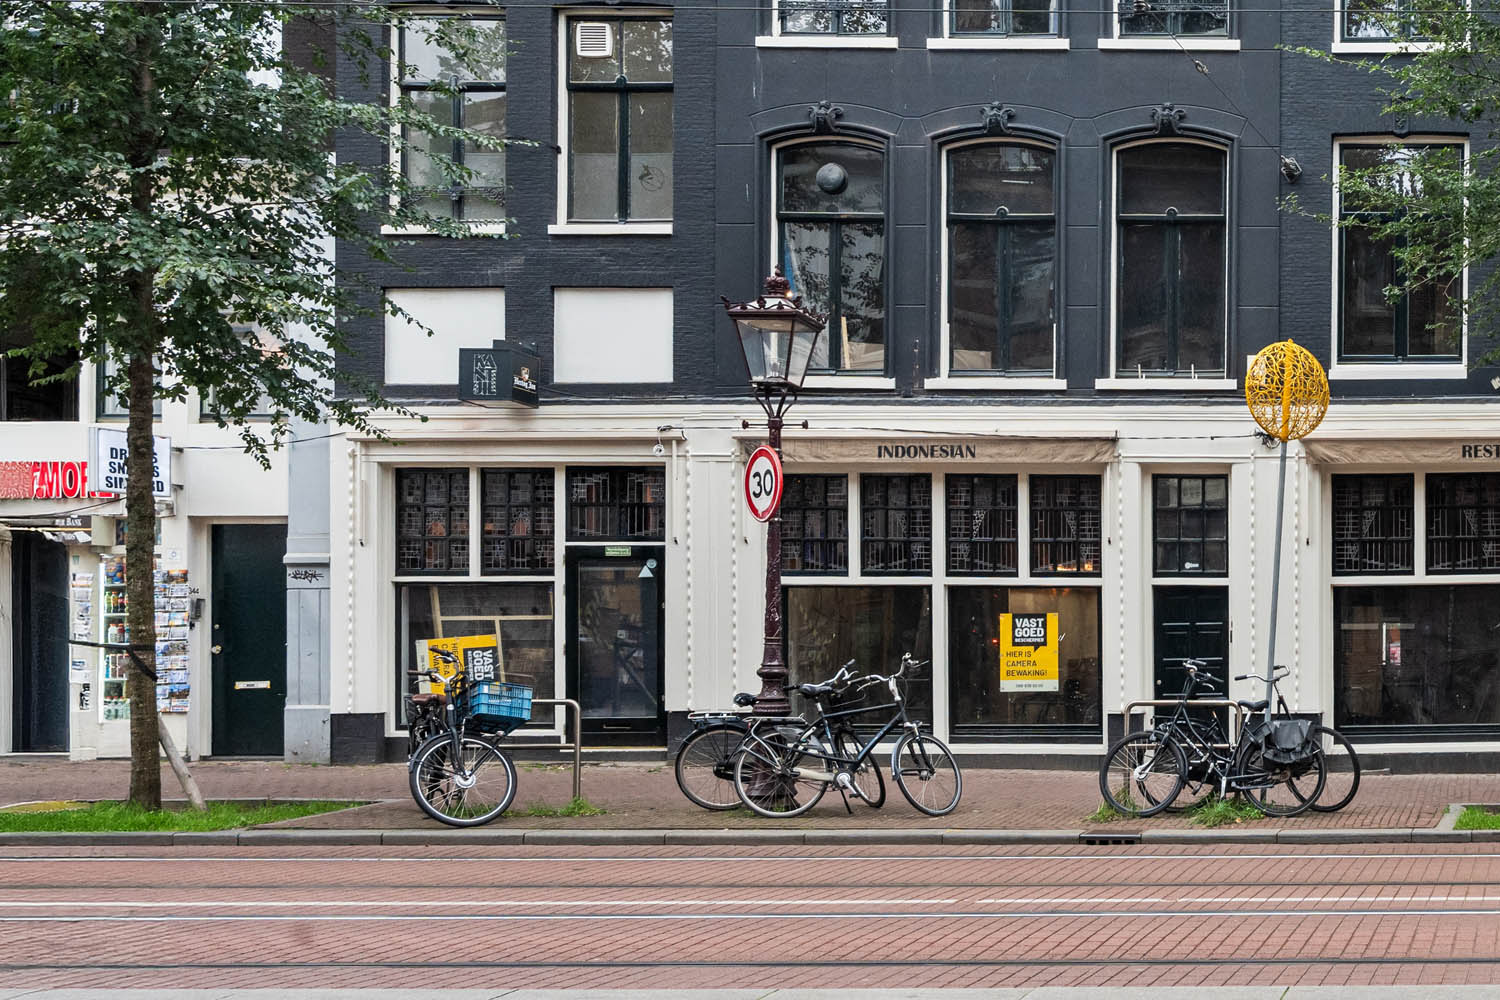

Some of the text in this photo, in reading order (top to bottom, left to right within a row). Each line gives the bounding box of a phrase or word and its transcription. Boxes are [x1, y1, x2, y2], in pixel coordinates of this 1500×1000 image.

[877, 444, 976, 458] INDONESIAN
[752, 469, 774, 498] 30
[1015, 618, 1044, 628] VAST
[1015, 627, 1044, 637] GOED
[1006, 650, 1032, 658] HIER IS
[473, 650, 485, 680] GOED
[483, 649, 495, 680] VAST
[1006, 669, 1048, 677] BEWAKING!
